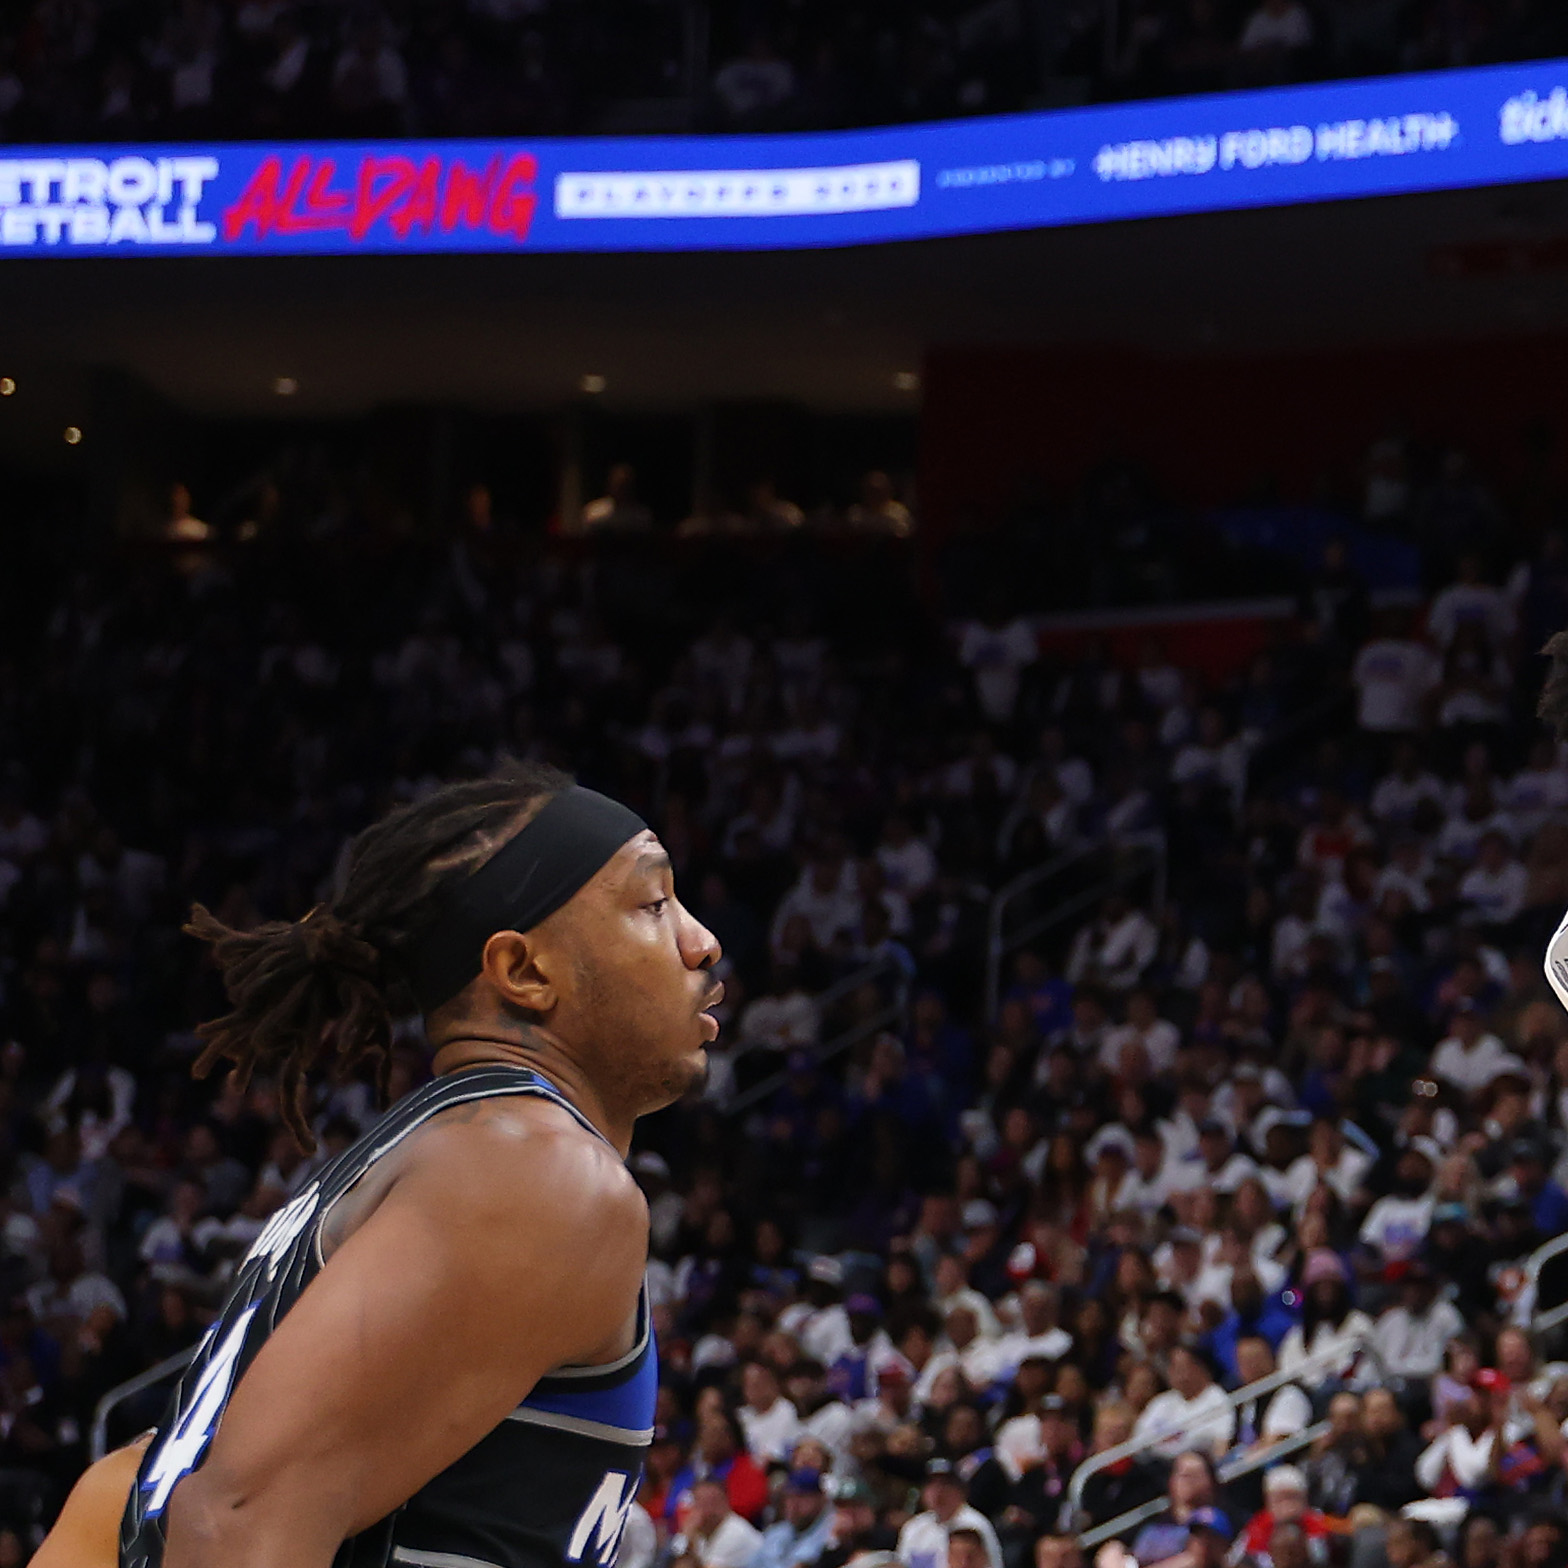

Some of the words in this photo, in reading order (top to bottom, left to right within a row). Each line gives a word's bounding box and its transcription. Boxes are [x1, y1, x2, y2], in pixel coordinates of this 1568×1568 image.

[1091, 133, 1217, 182] HENRY
[1218, 125, 1313, 171] FORD
[1314, 111, 1460, 163] HEALTH
[146, 1305, 257, 1512] 4
